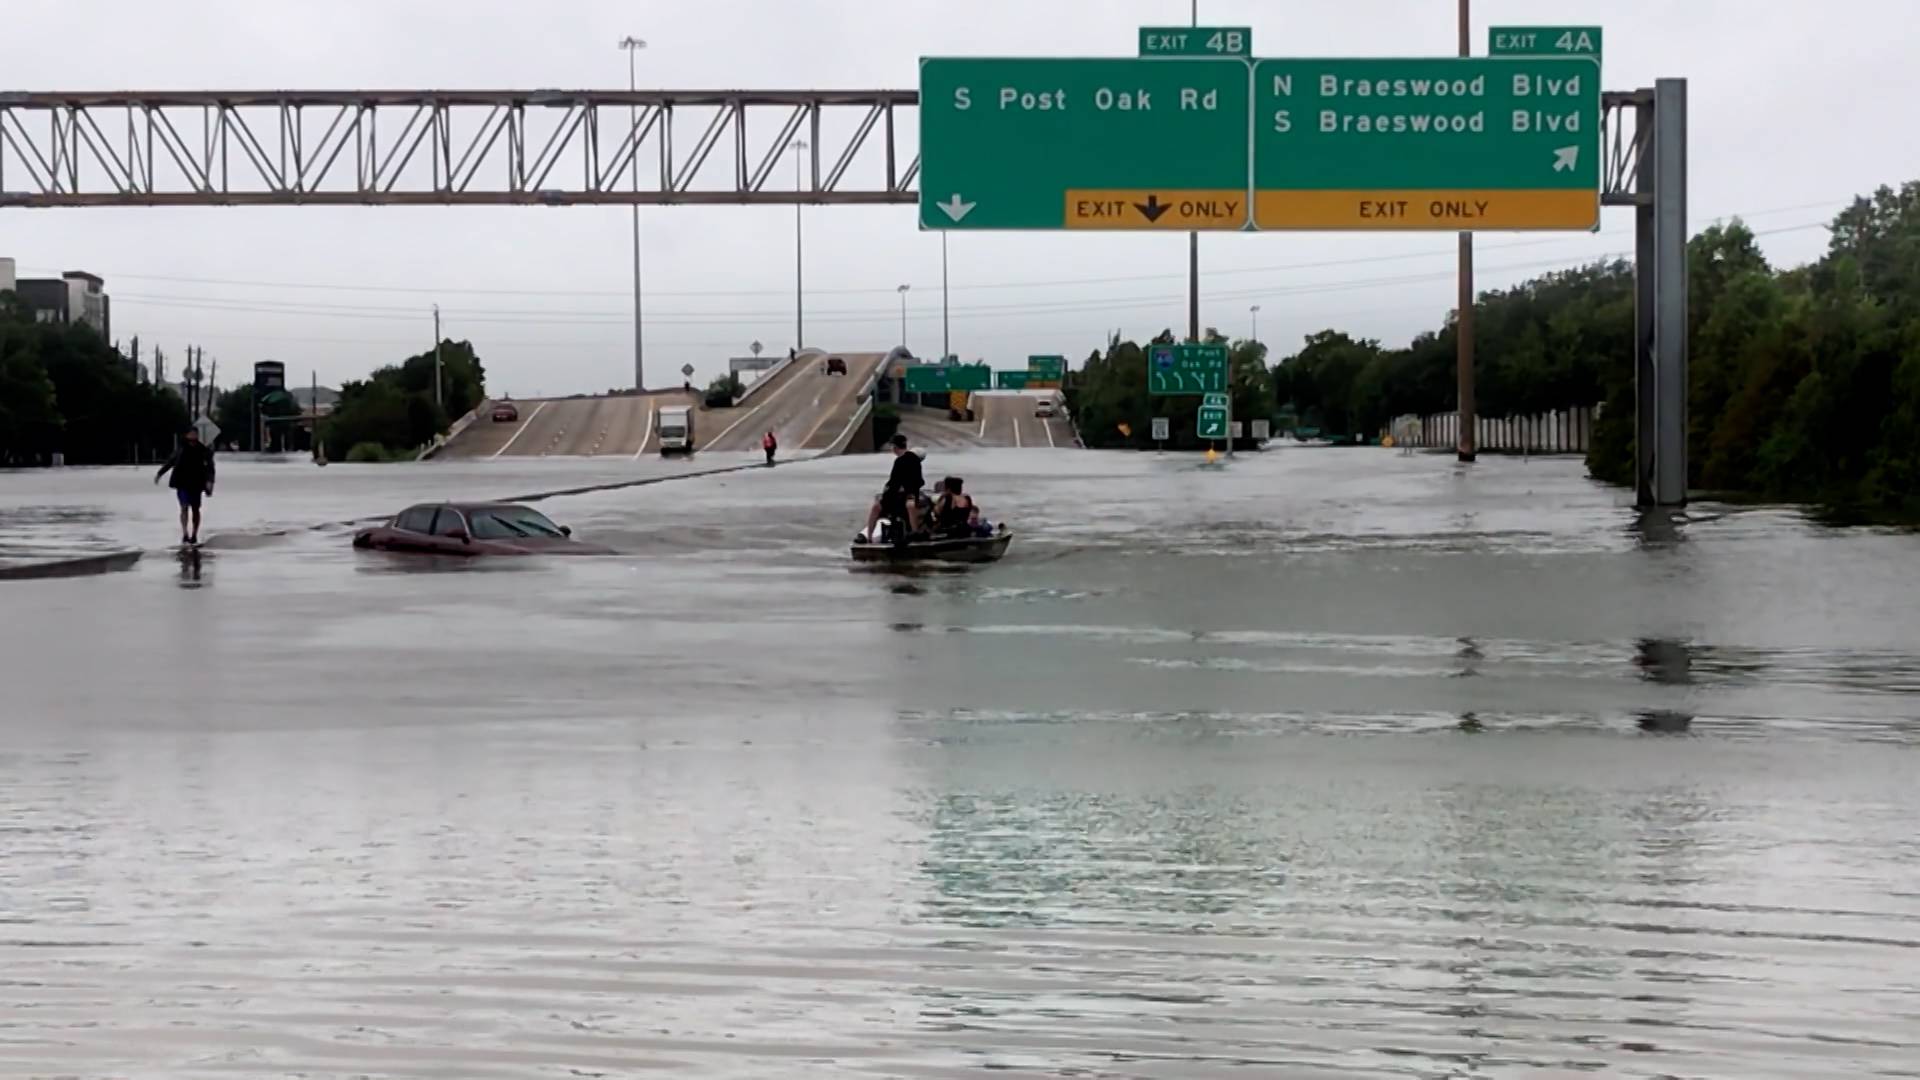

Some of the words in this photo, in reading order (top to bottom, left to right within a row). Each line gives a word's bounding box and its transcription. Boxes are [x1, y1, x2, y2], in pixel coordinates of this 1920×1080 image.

[1146, 34, 1188, 50] EXIT
[1205, 32, 1244, 53] 4B
[1495, 33, 1537, 49] EXIT
[1554, 31, 1594, 52] 4A
[1273, 74, 1292, 96] N
[1320, 74, 1485, 97] Braeswood
[1512, 73, 1580, 97] Blvd
[954, 87, 972, 110] S
[1000, 87, 1066, 110] Post
[1095, 87, 1151, 111] Oak
[1180, 88, 1217, 111] Rd
[1274, 110, 1292, 133] S
[1319, 109, 1484, 133] Braeswood
[1511, 109, 1580, 132] Blvd
[1077, 200, 1125, 218] EXIT
[1179, 200, 1239, 218] ONLY
[1359, 200, 1409, 218] EXIT
[1429, 200, 1489, 218] ONLY
